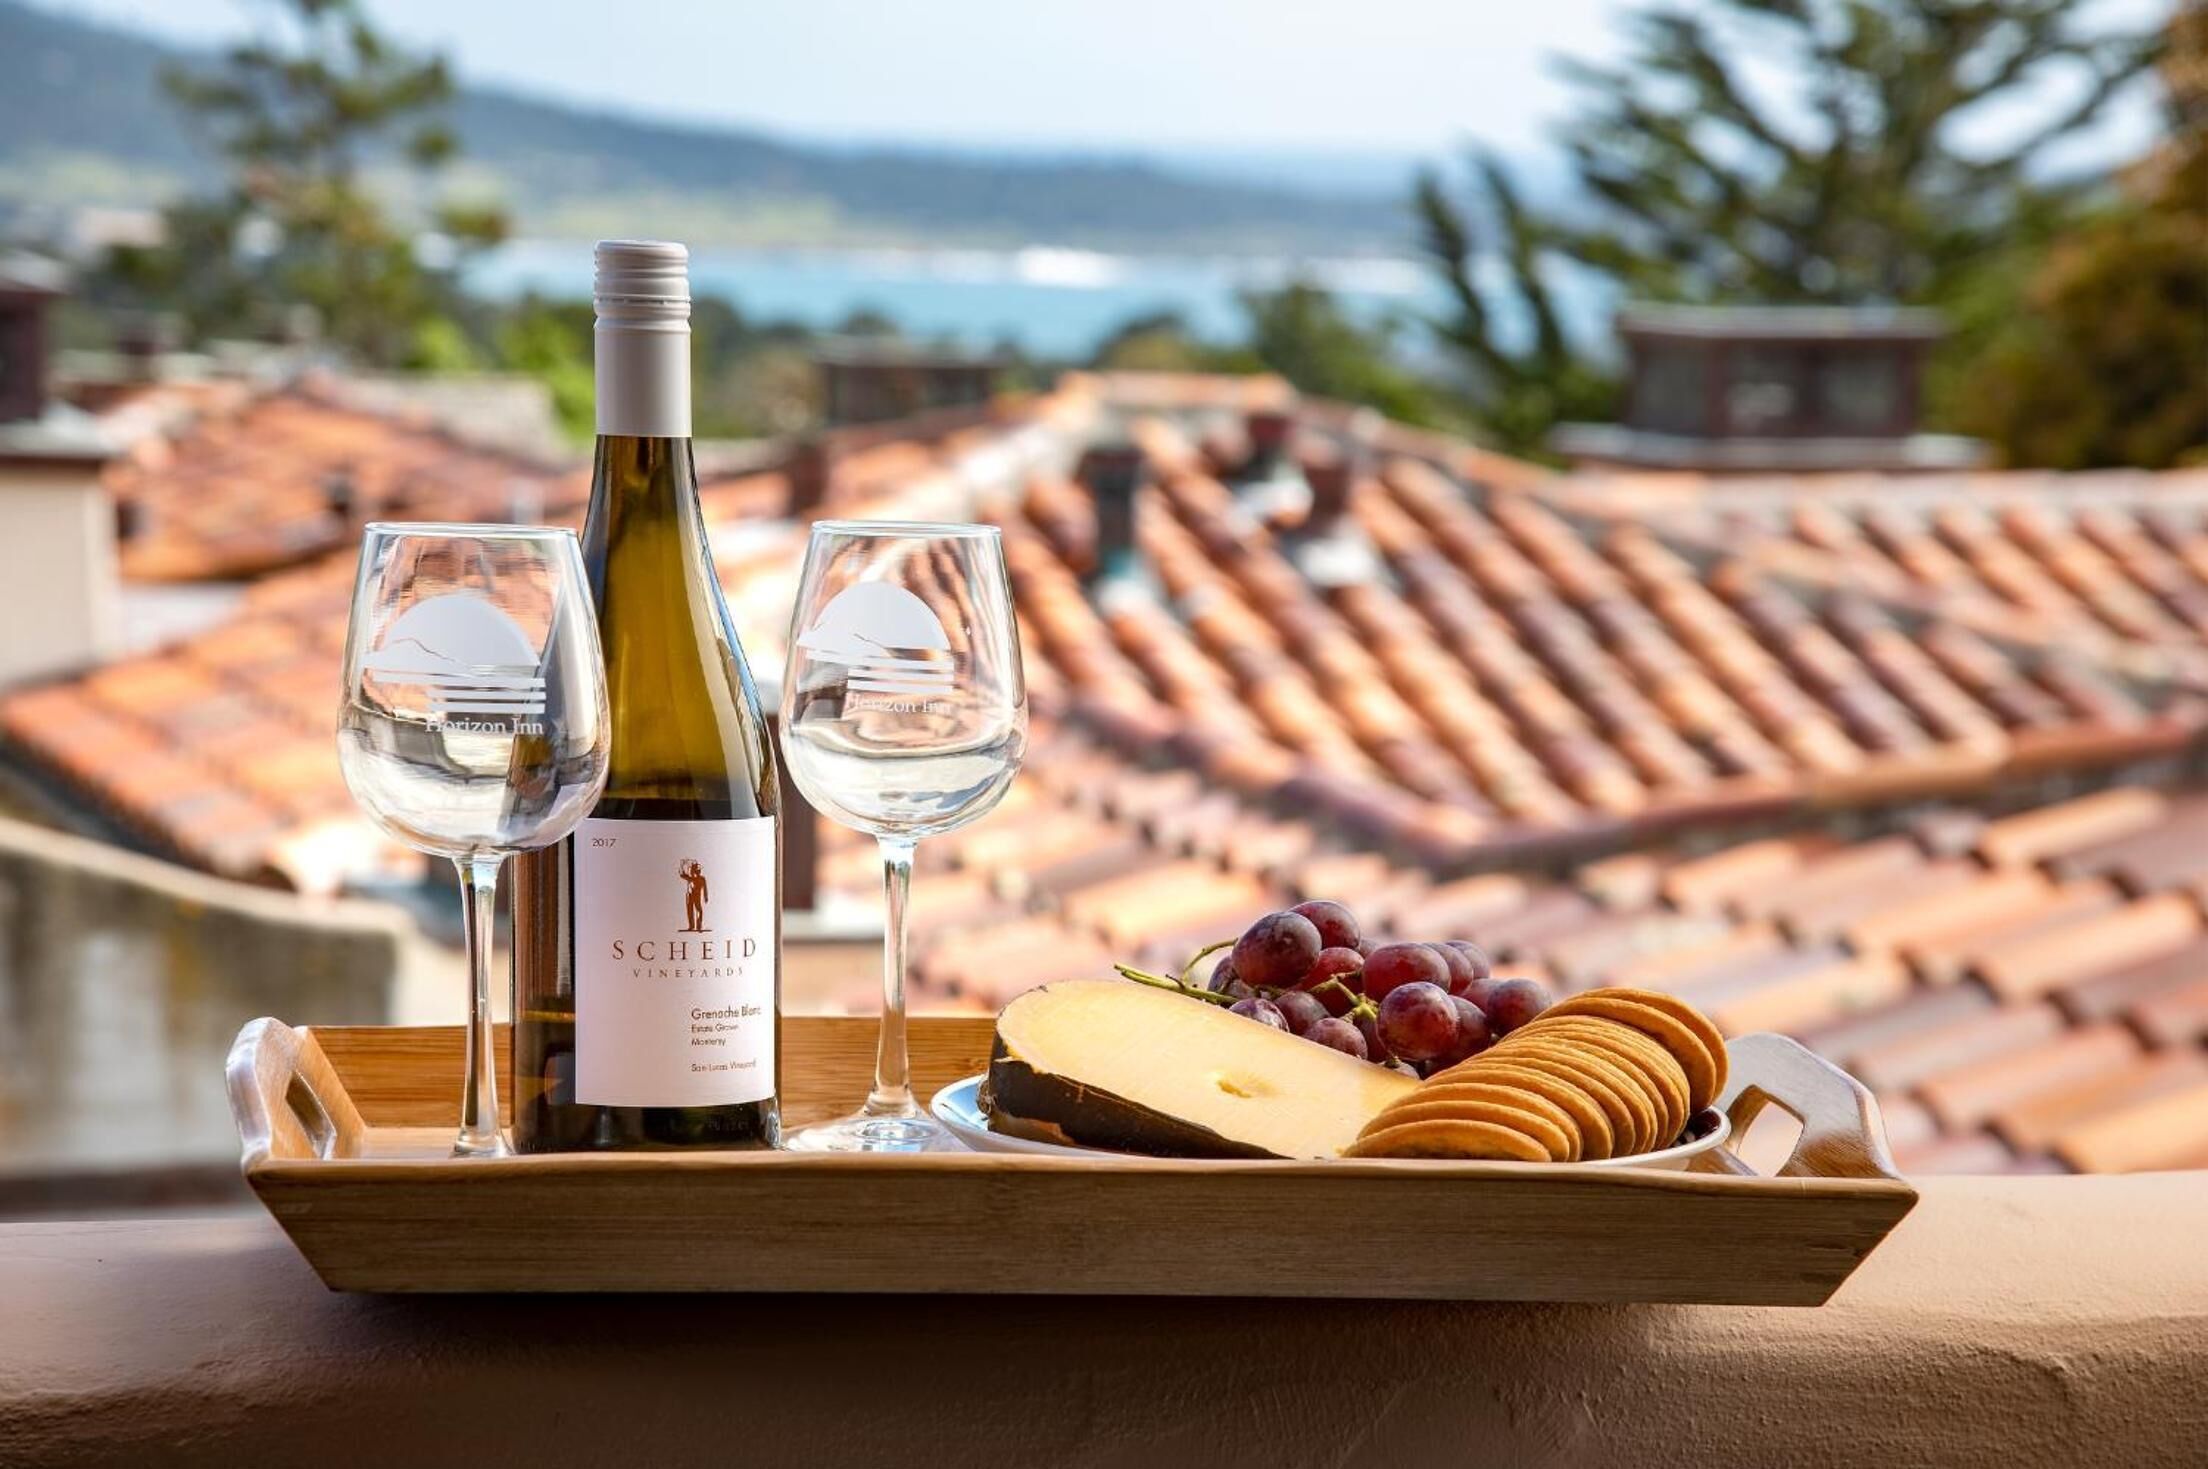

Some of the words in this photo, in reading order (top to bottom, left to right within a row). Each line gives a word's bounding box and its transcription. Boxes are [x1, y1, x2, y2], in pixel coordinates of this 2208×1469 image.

[424, 716, 508, 734] Horizon
[510, 717, 544, 735] Inn
[591, 837, 617, 848] 2017
[611, 937, 757, 962] SCHEID
[632, 967, 744, 979] VINEYARDS
[691, 1005, 740, 1020] Grenache
